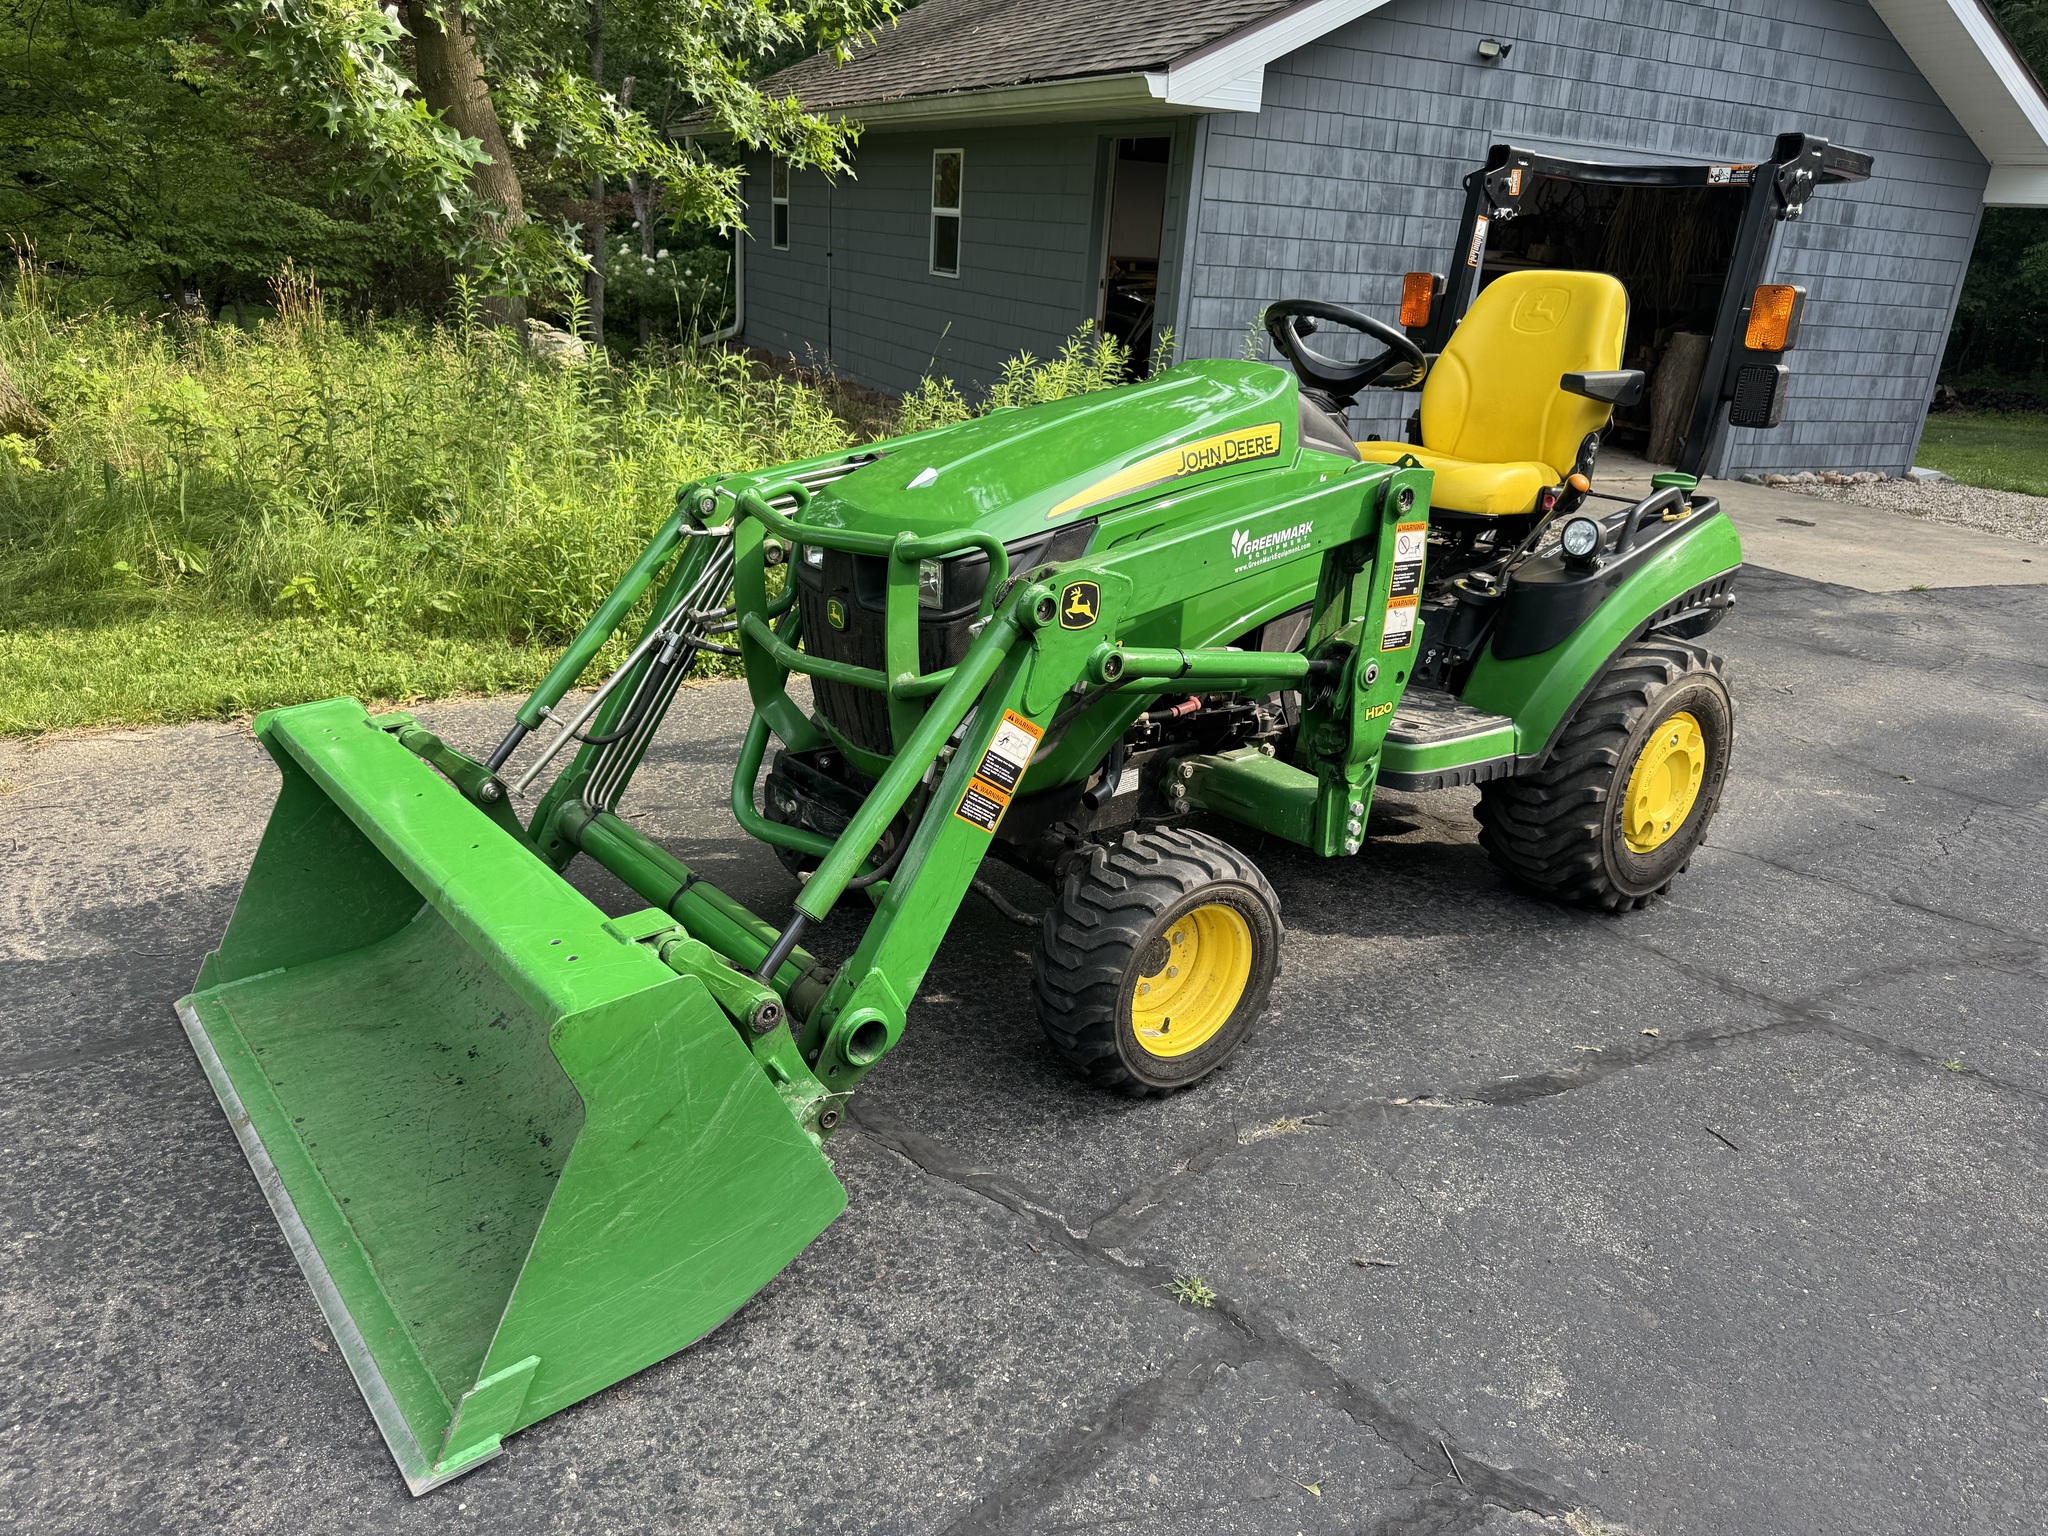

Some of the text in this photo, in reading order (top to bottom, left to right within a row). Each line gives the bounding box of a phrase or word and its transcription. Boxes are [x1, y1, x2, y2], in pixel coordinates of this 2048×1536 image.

[1177, 435, 1274, 473] JOHN DEERE
[1244, 520, 1314, 555] GREENMARK
[1401, 523, 1425, 532] WARNING
[1249, 535, 1308, 560] EQUIPMENT
[1234, 543, 1311, 574] www.GreenMarkEquipment.com
[1392, 598, 1416, 607] WARNING
[1364, 701, 1393, 721] H120
[1013, 717, 1039, 736] WARNING
[980, 785, 1005, 803] WARNING
